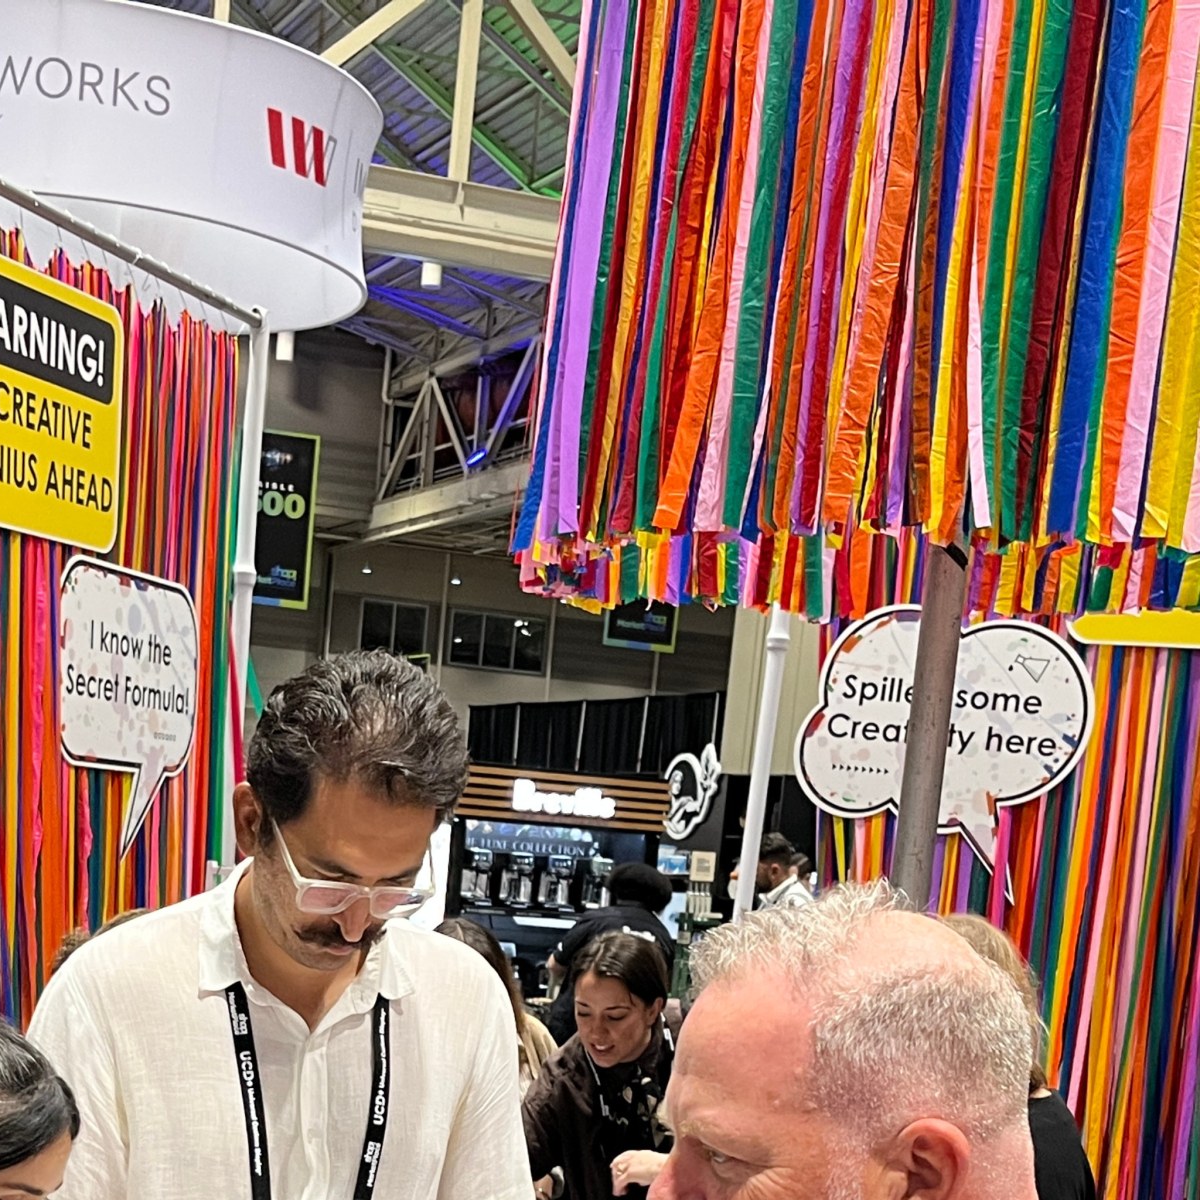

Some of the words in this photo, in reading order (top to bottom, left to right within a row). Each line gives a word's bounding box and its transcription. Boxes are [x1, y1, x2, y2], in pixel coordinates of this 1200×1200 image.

[45, 460, 114, 513] AHEAD
[256, 490, 306, 520] 00
[99, 621, 144, 661] know
[148, 633, 172, 666] the
[65, 663, 120, 703] Secret
[124, 675, 190, 716] Formula!
[842, 674, 915, 705] Spille
[955, 689, 1043, 715] some
[985, 726, 1057, 757] here
[239, 1050, 255, 1081] UCD
[373, 1095, 386, 1126] UCD
